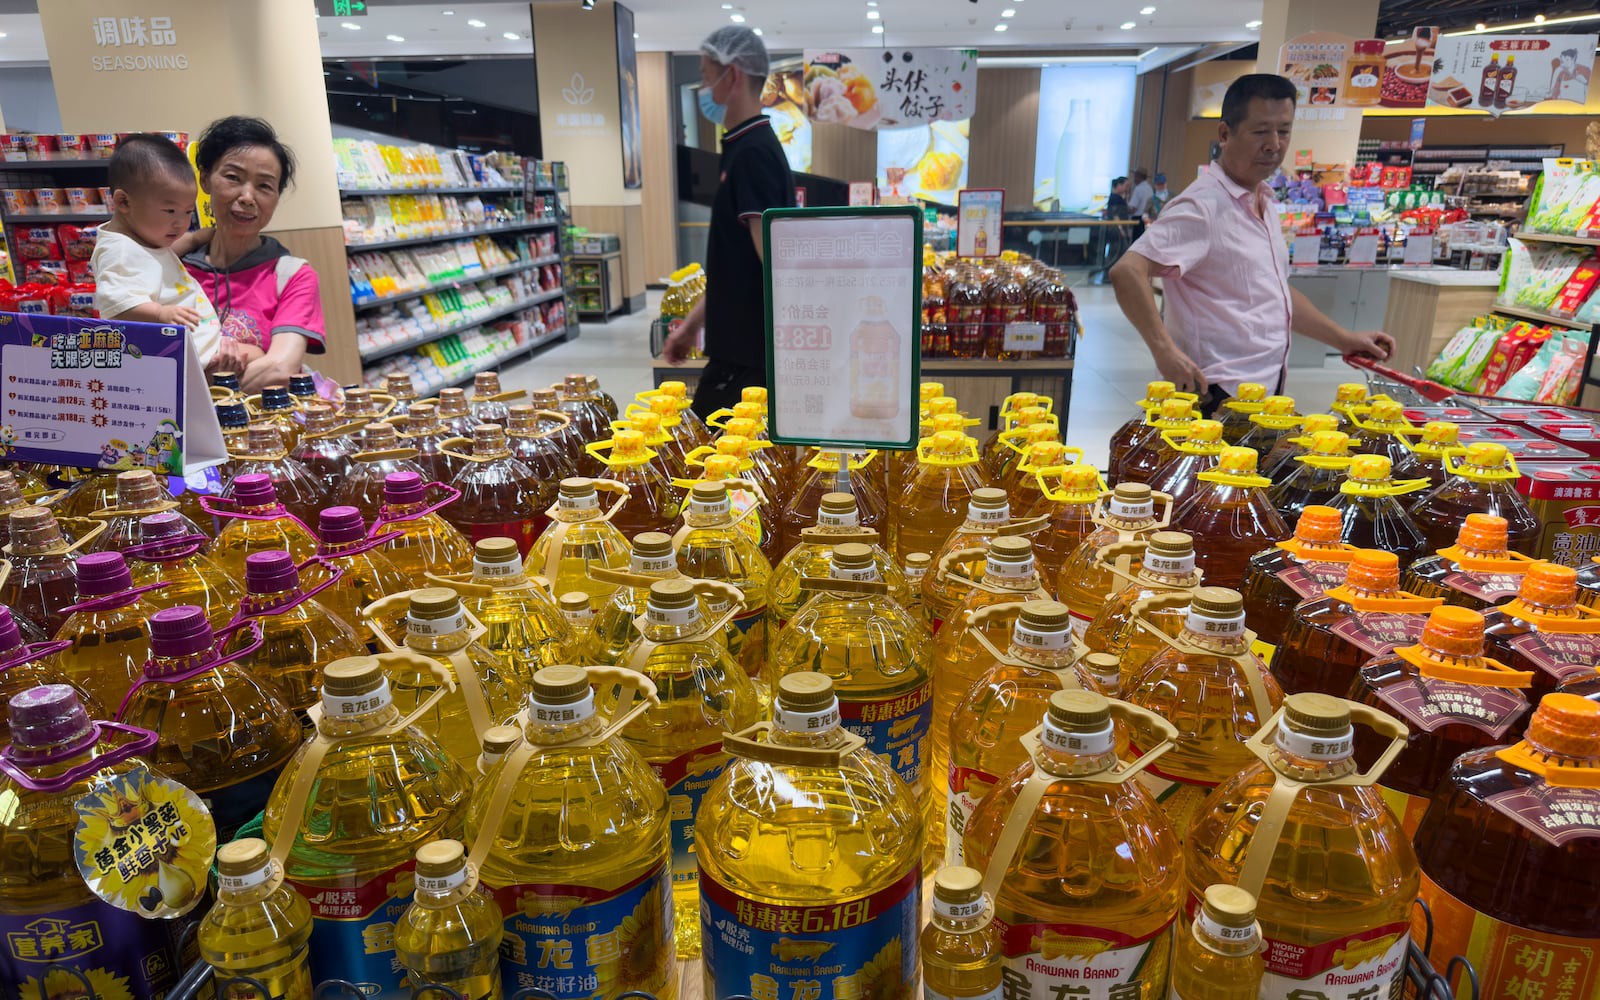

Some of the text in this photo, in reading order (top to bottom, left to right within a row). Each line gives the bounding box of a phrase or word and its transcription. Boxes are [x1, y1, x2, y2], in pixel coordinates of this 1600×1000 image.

[93, 17, 177, 47] 调味品
[92, 55, 188, 71] SEASONING
[880, 68, 929, 93] 头伏
[900, 95, 945, 118] 饺子
[1553, 487, 1593, 498] 滴滴鲁花
[1552, 533, 1600, 551] 高油
[481, 565, 512, 577] 金龙鱼
[642, 560, 670, 572] 金龙鱼
[1151, 558, 1182, 570] 金龙鱼
[1204, 620, 1239, 632] 金龙鱼
[341, 696, 380, 713] 金龙鱼
[536, 708, 576, 723] 金龙鱼
[1046, 728, 1082, 751] 金龙鱼
[1310, 741, 1350, 755] 金龙鱼
[1549, 800, 1600, 818] 中国发明
[418, 877, 449, 889] 金龙鱼
[324, 891, 357, 906] 脱壳
[735, 898, 878, 934] 特惠装6.18L
[949, 903, 981, 917] 金龙鱼
[515, 918, 560, 935] ARAWANA
[15, 928, 96, 957] 营养家
[501, 930, 622, 970] 金龙鱼
[1272, 940, 1306, 955] WORLD
[1271, 948, 1301, 961] HEART
[1271, 955, 1289, 965] DAY
[769, 962, 811, 976] ARAWANA
[1026, 958, 1120, 979] ARAWANA BRAND
[517, 971, 598, 994] 葵花籽油
[1324, 970, 1374, 986] ARAWANA
